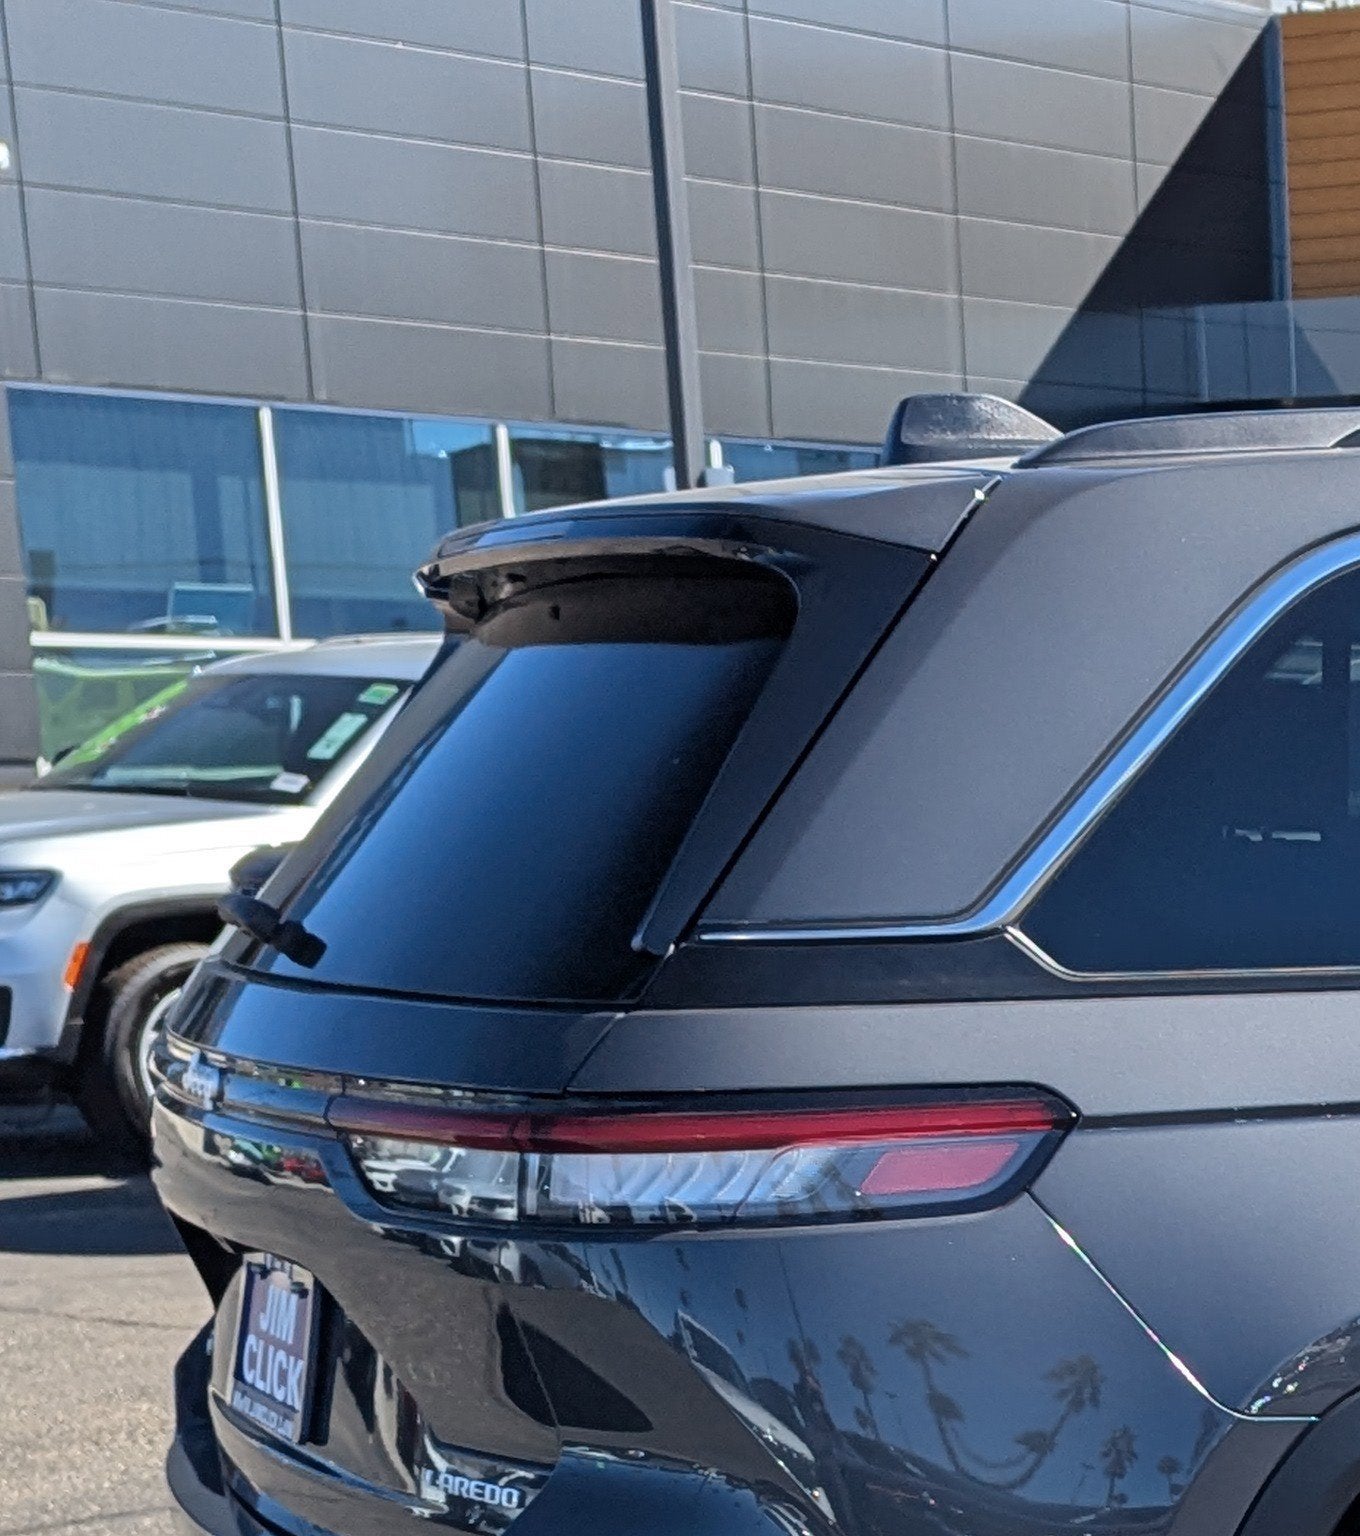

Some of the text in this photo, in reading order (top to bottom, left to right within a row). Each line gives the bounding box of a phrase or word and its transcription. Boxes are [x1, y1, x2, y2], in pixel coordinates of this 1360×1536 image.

[259, 1284, 299, 1345] JIM
[243, 1333, 305, 1412] CLICK
[422, 1467, 521, 1509] LAREDO
